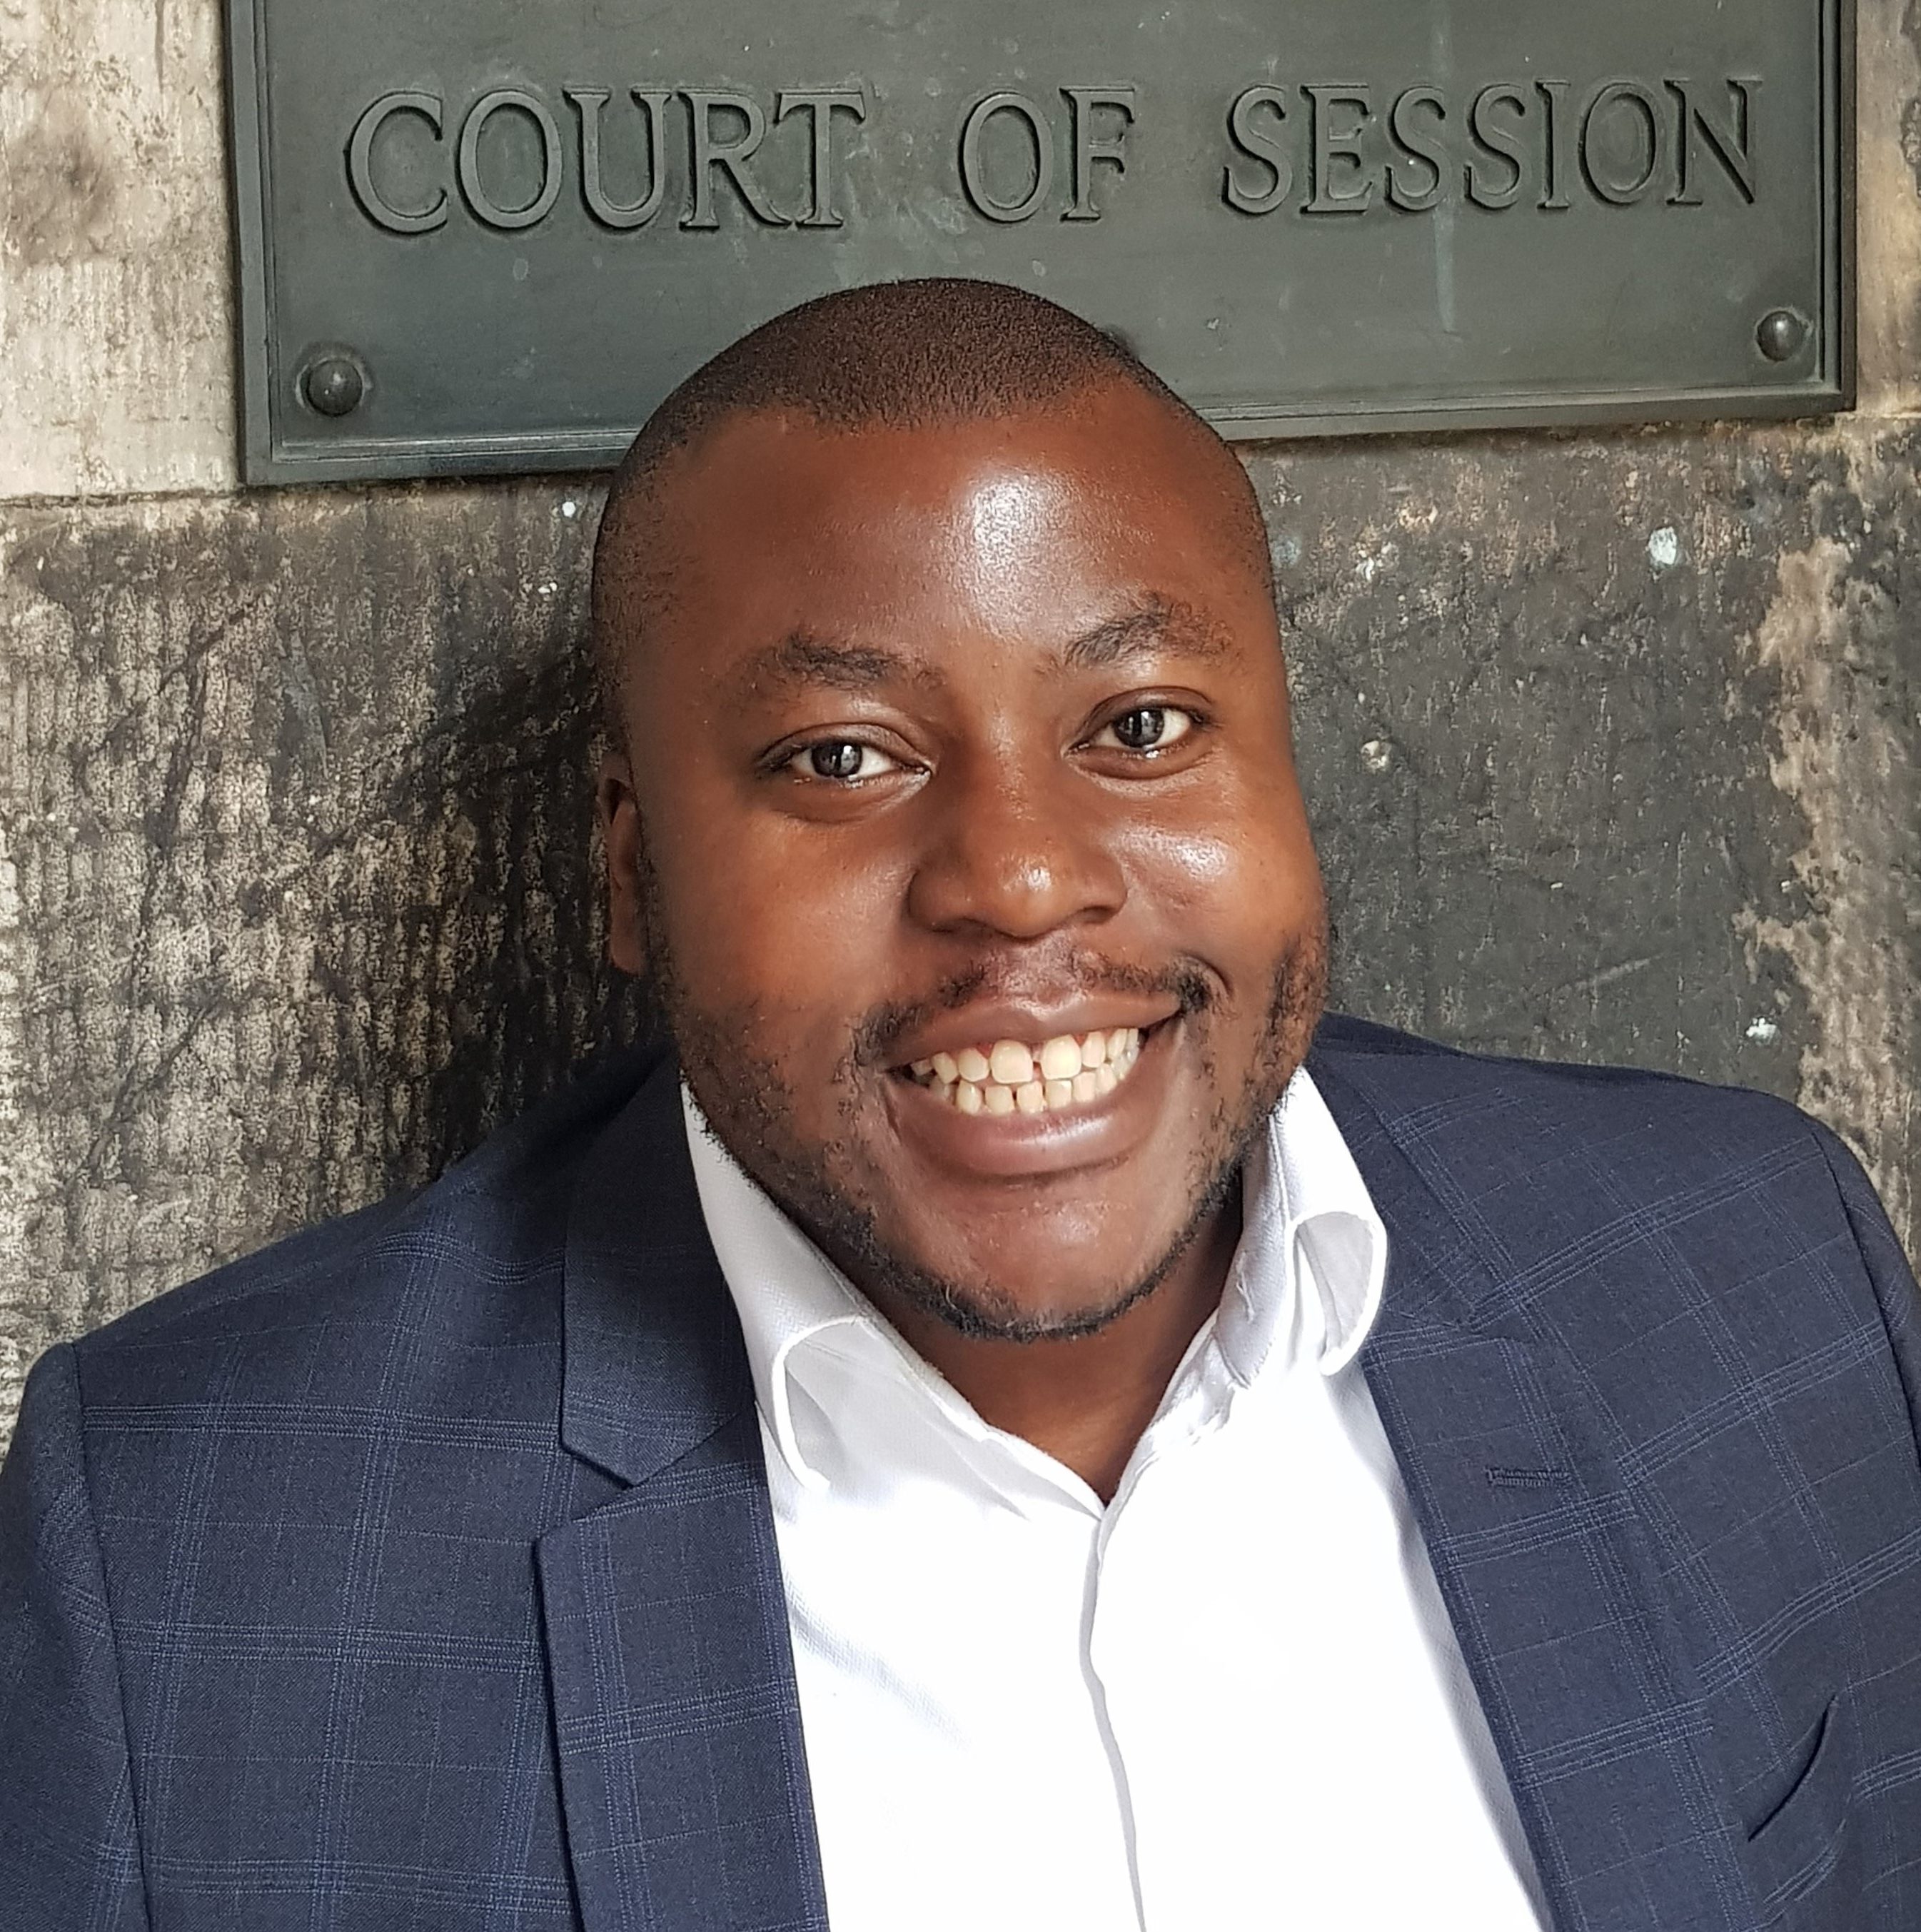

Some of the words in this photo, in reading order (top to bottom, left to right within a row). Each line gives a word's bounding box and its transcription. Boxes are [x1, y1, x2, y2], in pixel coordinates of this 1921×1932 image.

[343, 88, 866, 234] COURT
[957, 84, 1136, 224] OF
[1221, 77, 1763, 217] SESSION
